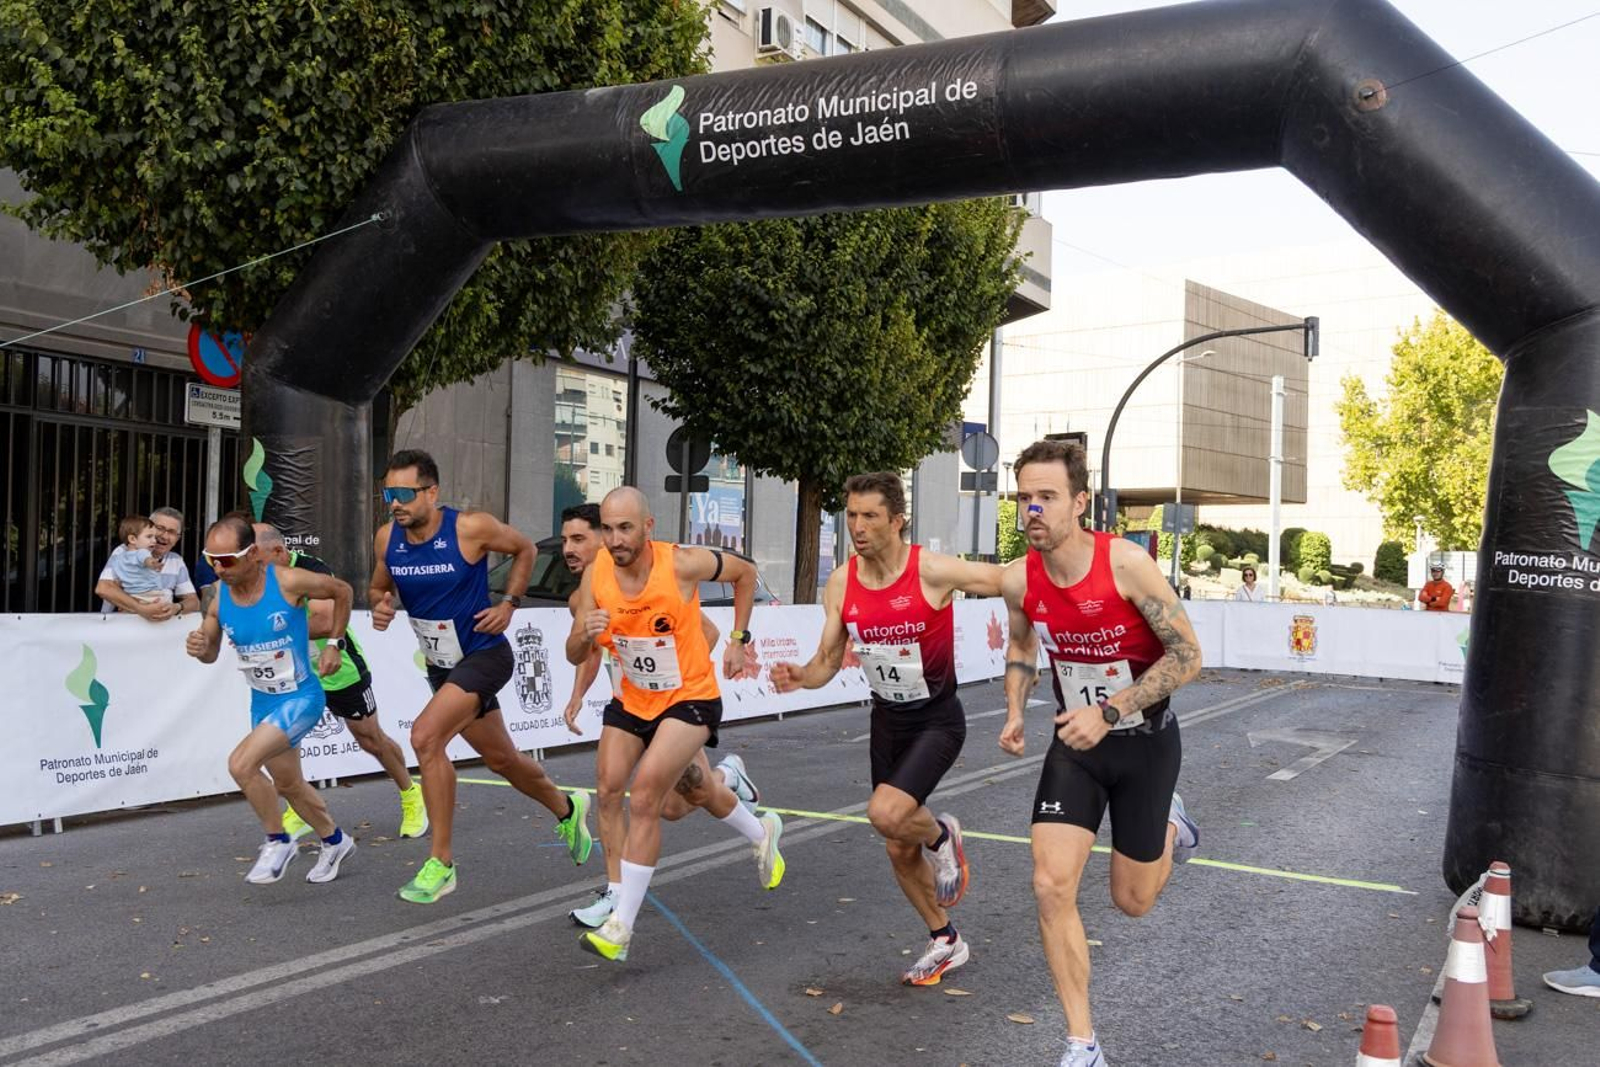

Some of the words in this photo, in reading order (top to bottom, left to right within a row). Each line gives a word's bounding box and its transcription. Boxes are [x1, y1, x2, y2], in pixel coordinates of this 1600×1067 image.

[699, 102, 809, 134] Patronato
[817, 81, 936, 119] Municipal
[944, 79, 978, 101] de
[700, 128, 805, 165] Deportes
[812, 126, 843, 150] de
[850, 117, 910, 146] Jaén
[284, 534, 302, 547] pal
[304, 534, 320, 545] de
[390, 563, 455, 576] TROTASIERRA
[1495, 551, 1566, 569] Patronato
[1572, 555, 1600, 573] Mu
[1508, 569, 1584, 589] Deportes
[253, 667, 275, 679] 55
[633, 656, 656, 673] 49
[875, 664, 901, 683] 14
[1060, 664, 1073, 677] 37
[1080, 685, 1110, 706] 15
[510, 720, 540, 732] CIUDAD
[323, 743, 338, 756] DE
[39, 756, 92, 771] Patronato
[94, 751, 145, 765] Municipal
[147, 748, 159, 759] de
[56, 769, 106, 785] Deportes
[108, 766, 122, 777] de
[125, 762, 148, 776] Jaén
